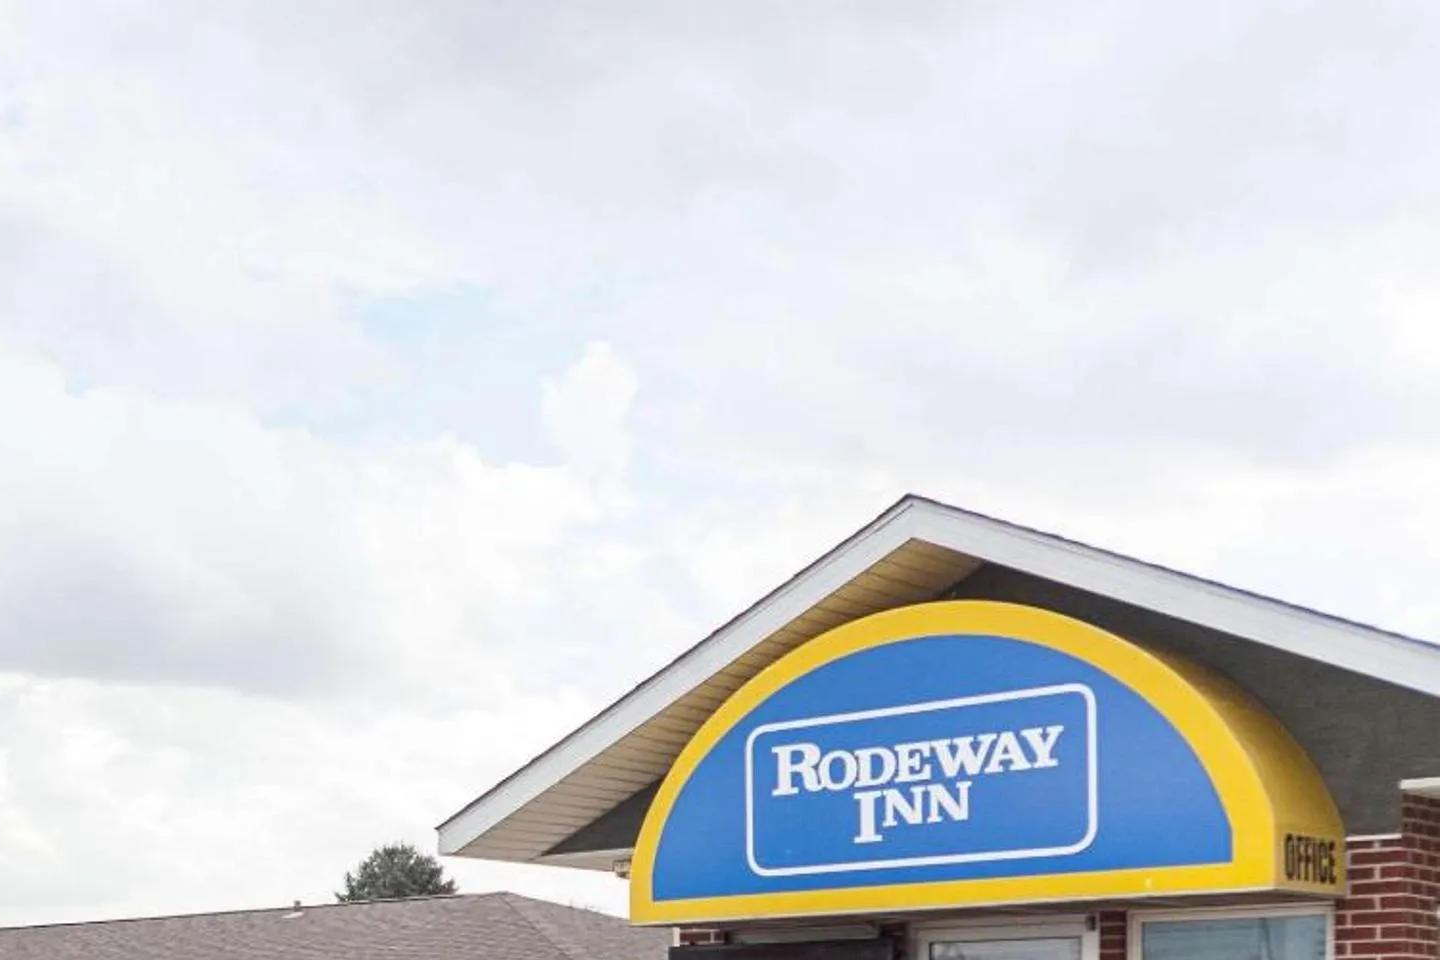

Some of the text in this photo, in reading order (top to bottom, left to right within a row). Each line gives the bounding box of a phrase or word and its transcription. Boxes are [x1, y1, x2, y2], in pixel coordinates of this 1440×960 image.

[771, 724, 1064, 796] RODEWAY
[853, 780, 972, 843] INN
[1284, 832, 1337, 885] OFFICE
